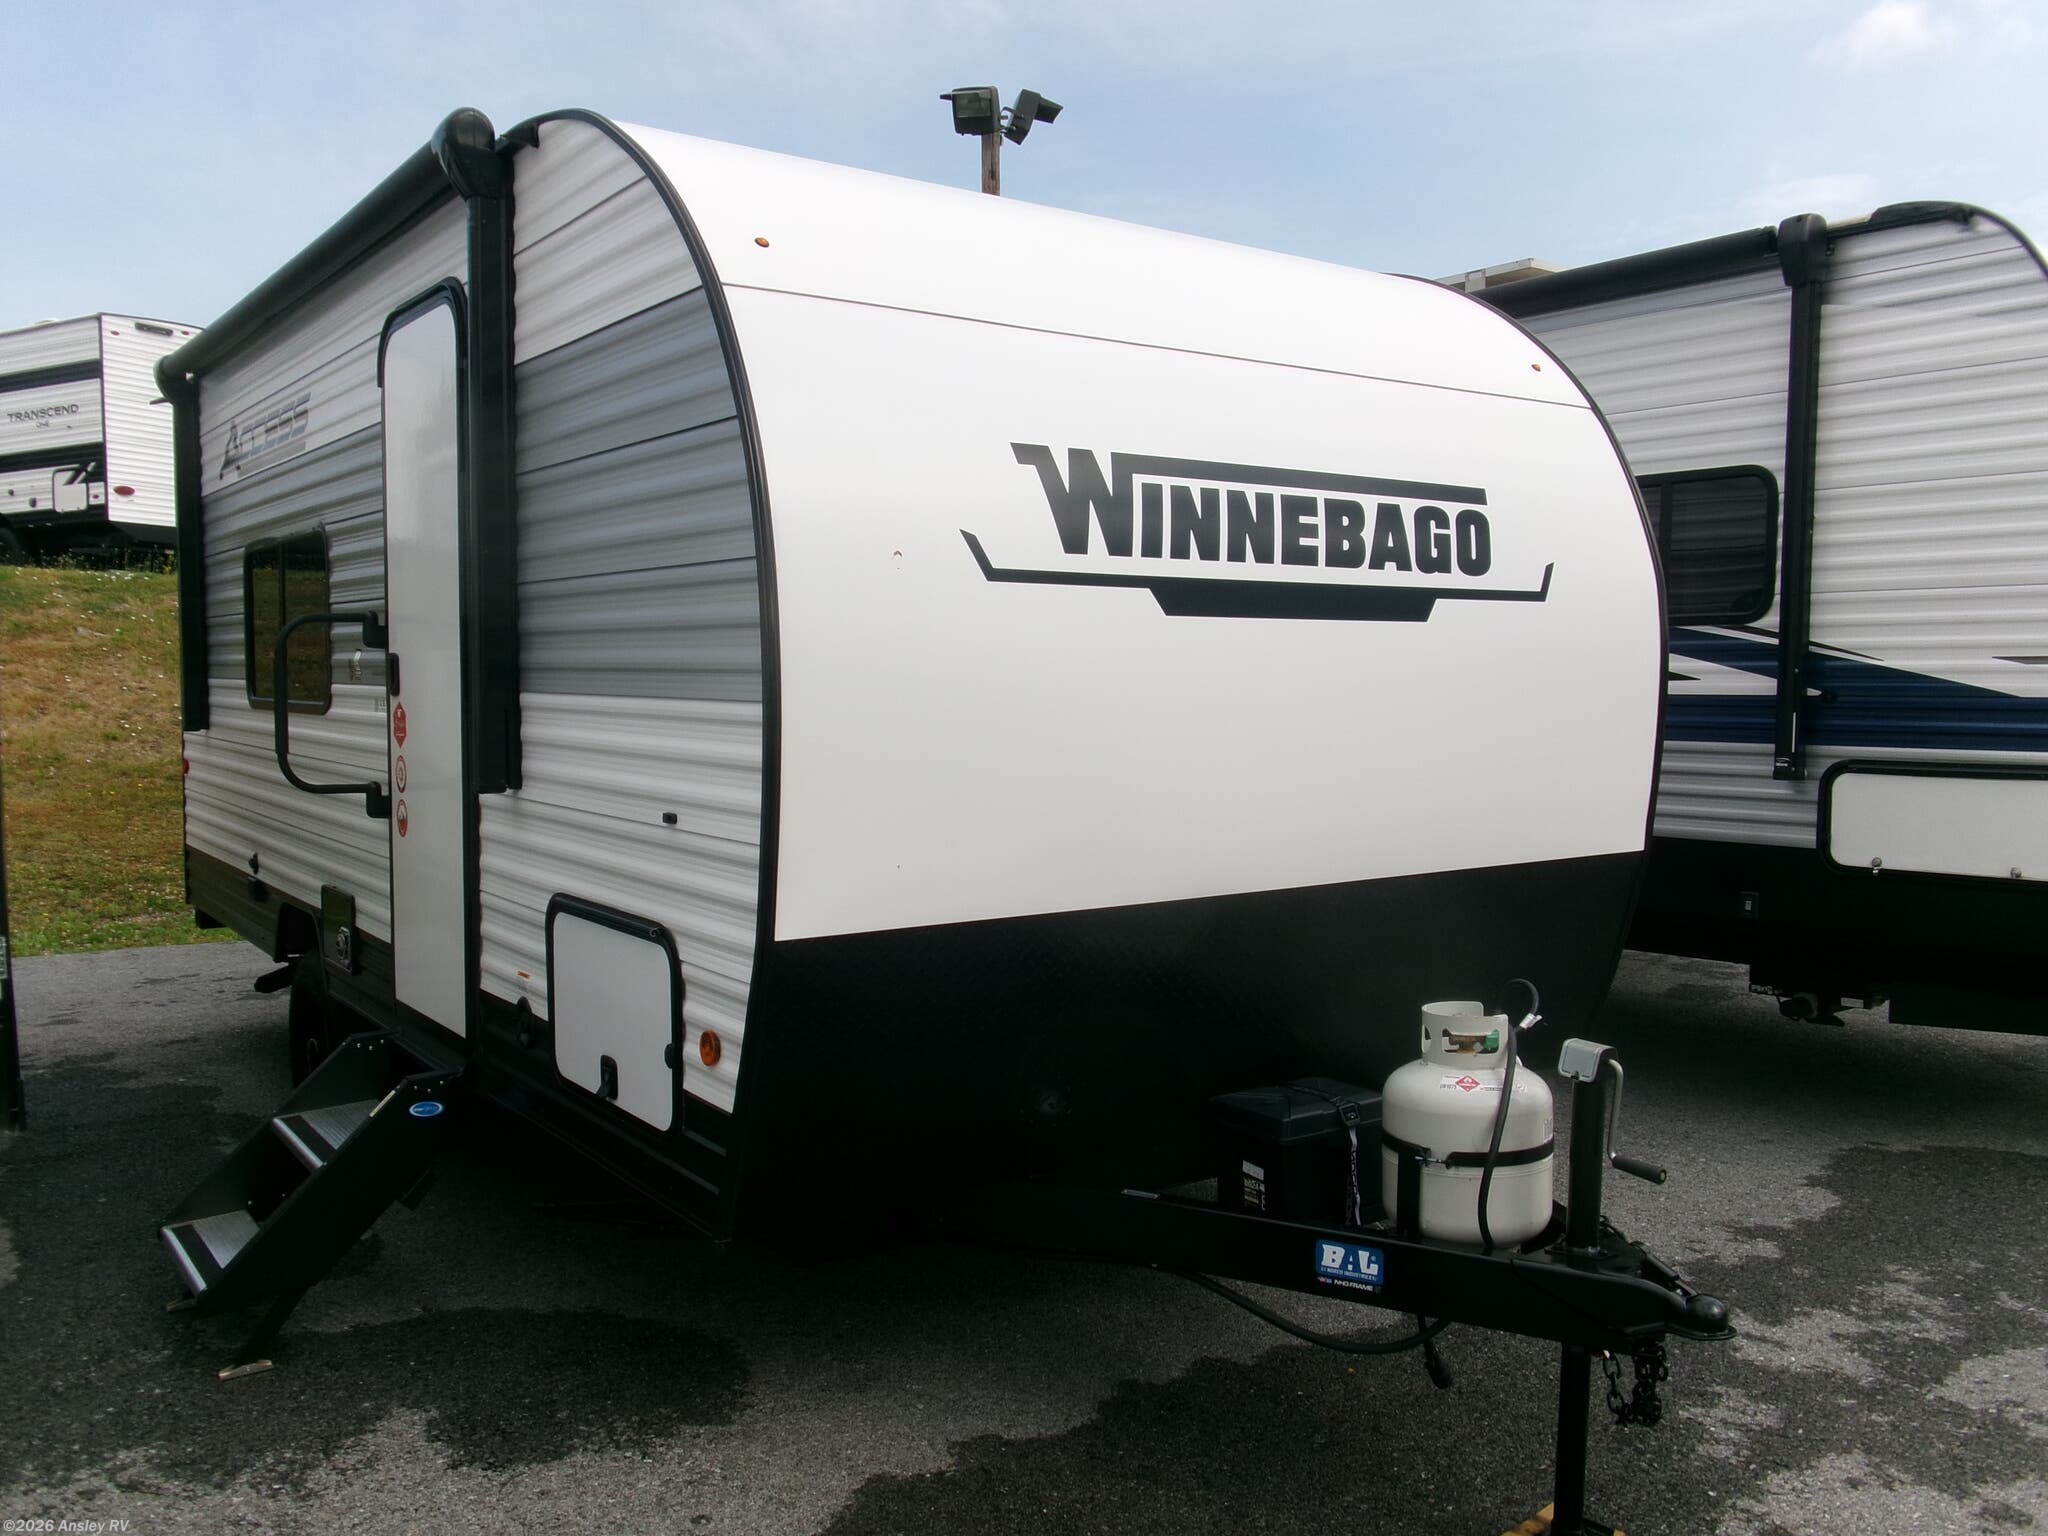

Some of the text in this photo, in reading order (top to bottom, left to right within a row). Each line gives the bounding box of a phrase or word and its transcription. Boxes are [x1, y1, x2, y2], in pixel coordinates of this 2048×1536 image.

[7, 403, 80, 423] TRANSCEND
[1010, 442, 1492, 577] WINNEBAGO
[1321, 1244, 1379, 1276] BAL
